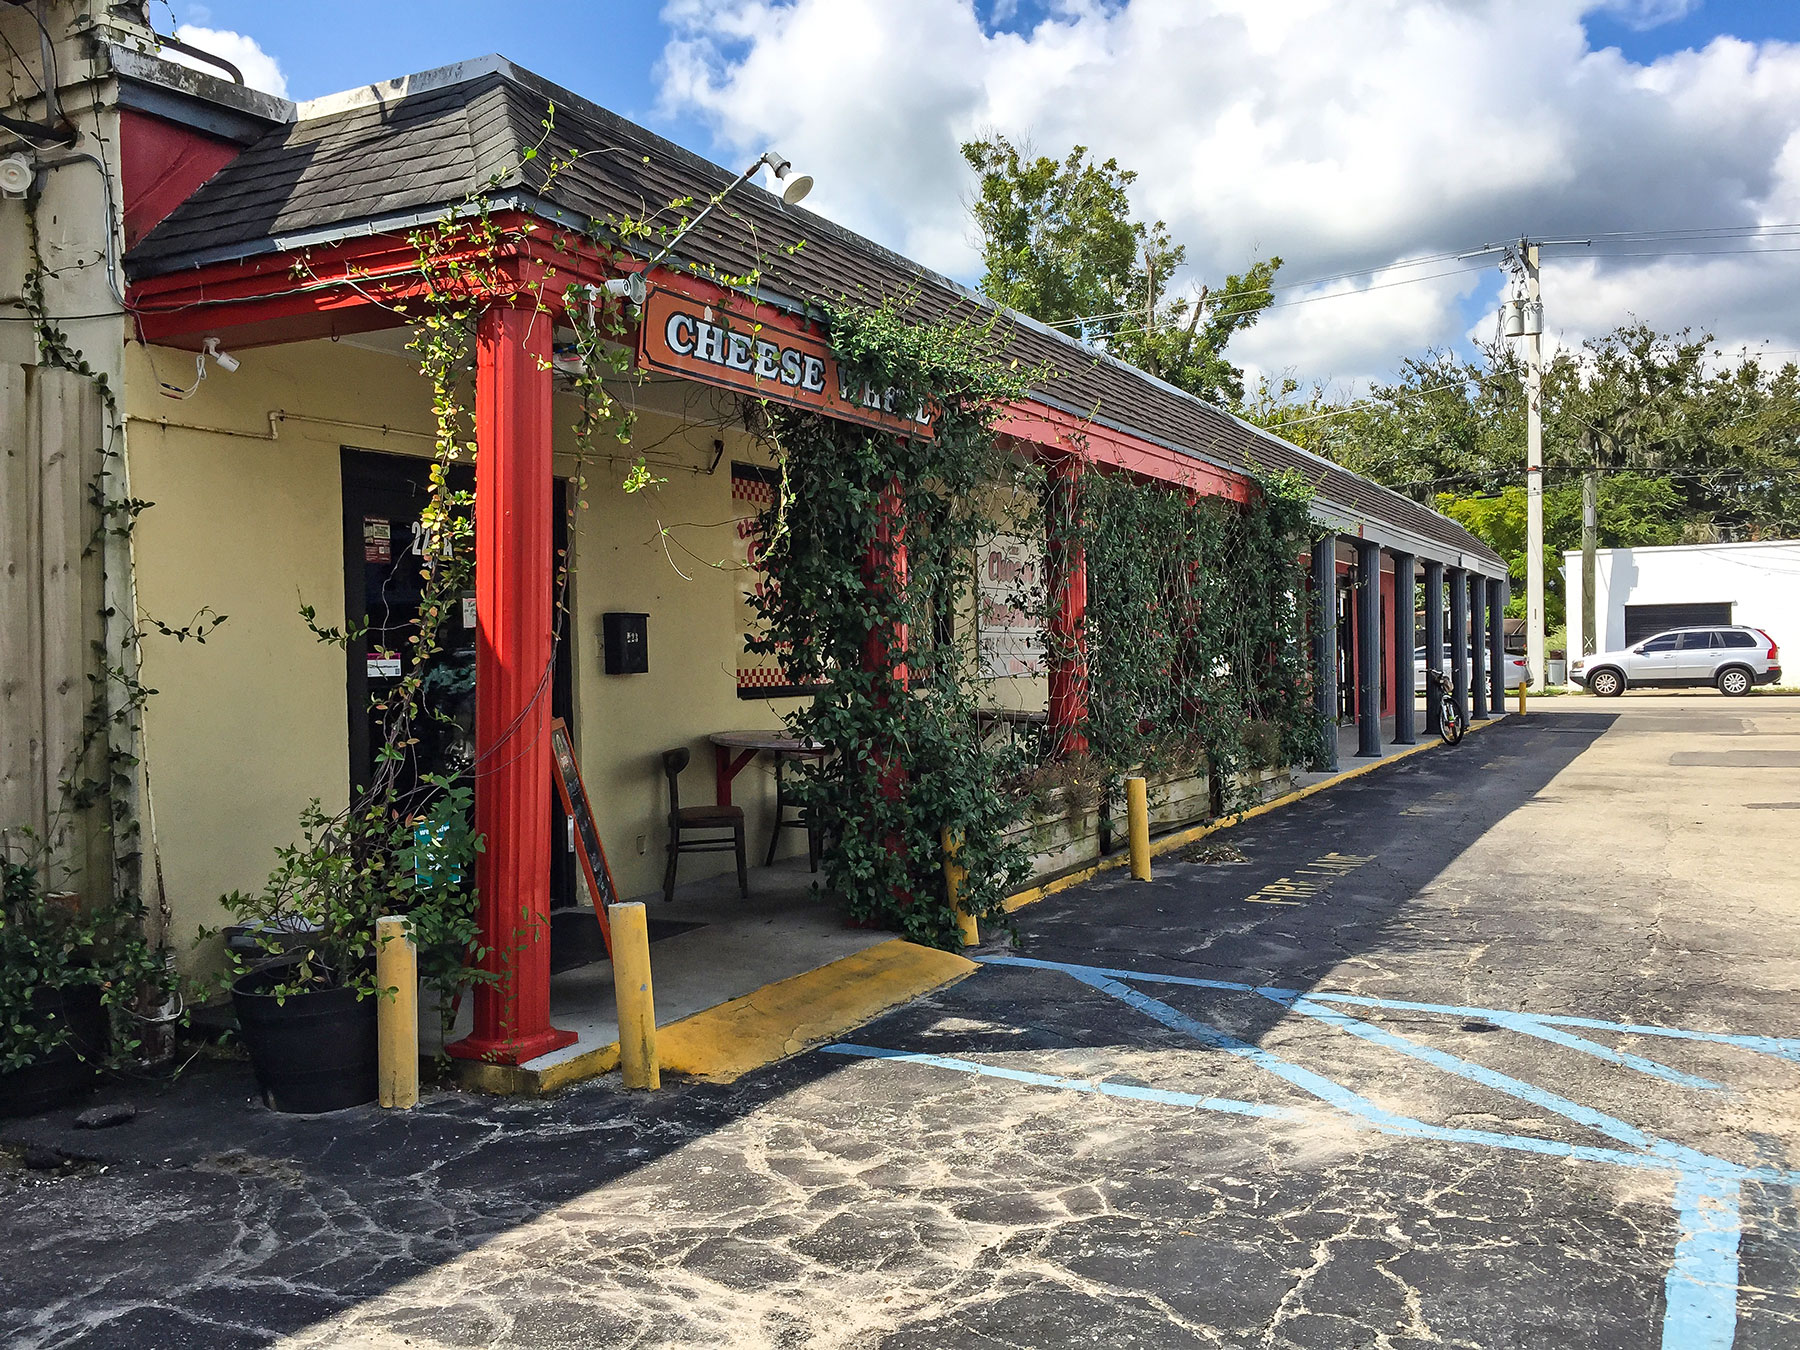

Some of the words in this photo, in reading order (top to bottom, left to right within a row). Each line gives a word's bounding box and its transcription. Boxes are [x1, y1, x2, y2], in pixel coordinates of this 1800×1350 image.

[666, 314, 825, 393] CHEESE
[1244, 877, 1334, 905] FIRE
[1295, 852, 1377, 876] LANE
